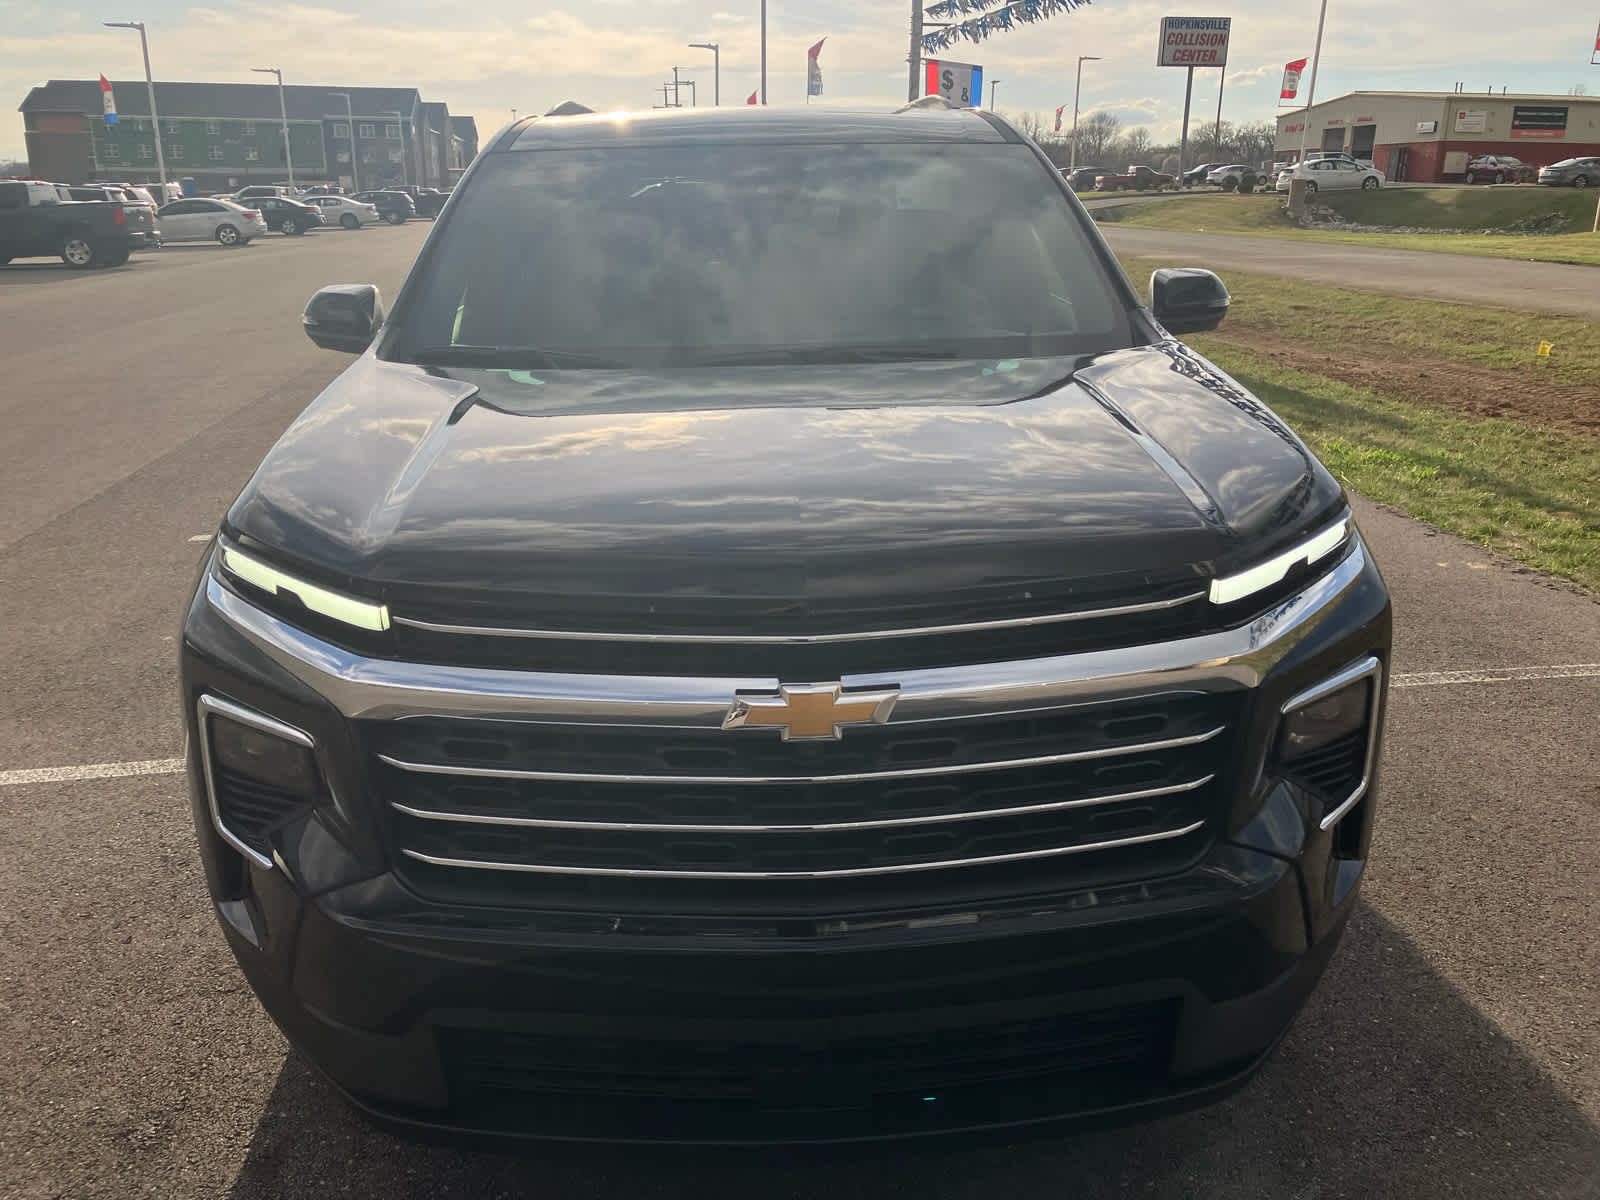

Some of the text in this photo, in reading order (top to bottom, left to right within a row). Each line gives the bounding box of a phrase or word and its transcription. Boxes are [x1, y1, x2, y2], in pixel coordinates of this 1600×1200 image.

[1168, 18, 1228, 30] HOPKINSVILLE
[1167, 32, 1227, 46] COLLISION
[1172, 49, 1217, 62] CENTER
